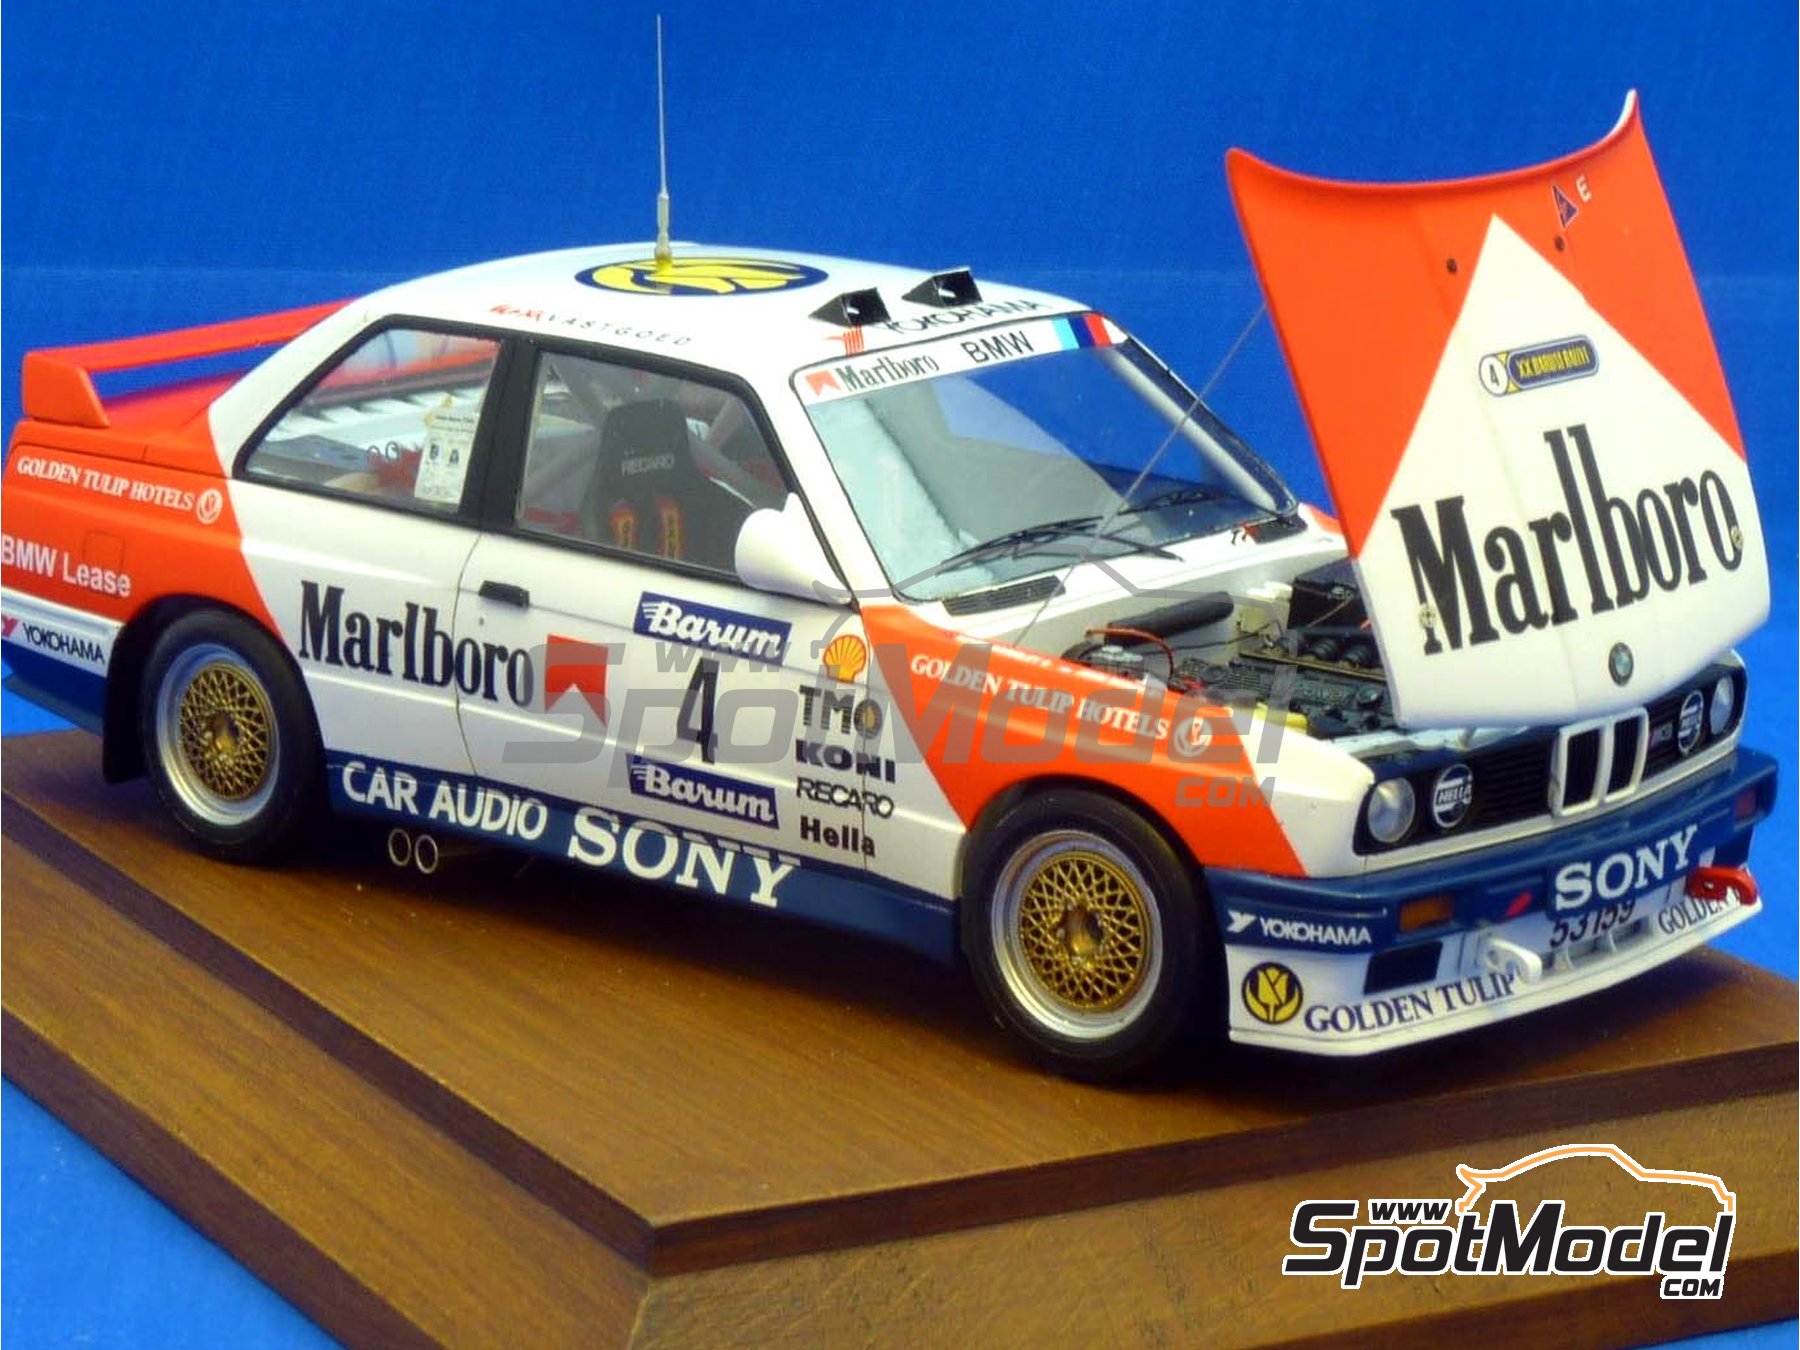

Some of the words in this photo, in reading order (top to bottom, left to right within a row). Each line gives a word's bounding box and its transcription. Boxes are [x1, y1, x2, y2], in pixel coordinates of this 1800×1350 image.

[1576, 175, 1593, 202] E
[834, 353, 940, 394] Marlboro
[960, 330, 1035, 364] BMW
[1488, 363, 1500, 387] 4
[17, 456, 81, 485] GOLDEN
[82, 469, 130, 498] TULIP
[130, 483, 194, 511] HOTELS
[0, 532, 58, 578] BMW
[62, 551, 132, 597] Lease
[1390, 423, 1744, 656] Marlboro
[22, 621, 106, 665] YOKOHAMA
[299, 580, 535, 707] Marlboro
[644, 600, 783, 658] Barum
[676, 657, 721, 766] 4
[910, 653, 1003, 696] GOLDEN
[1004, 679, 1075, 714] TULIP
[1076, 698, 1169, 741] HOTELS
[794, 738, 896, 783] KONI
[636, 763, 775, 823] Barum
[796, 776, 895, 820] RECARO
[342, 760, 419, 816] CAR
[429, 779, 549, 841] AUDIO
[567, 806, 801, 909] SONY
[799, 814, 876, 859] Hella
[1555, 824, 1698, 911] SONY
[1259, 916, 1372, 945] YOKOHAMA
[1304, 989, 1435, 1033] GOLDEN
[1435, 970, 1515, 1009] TULIP
